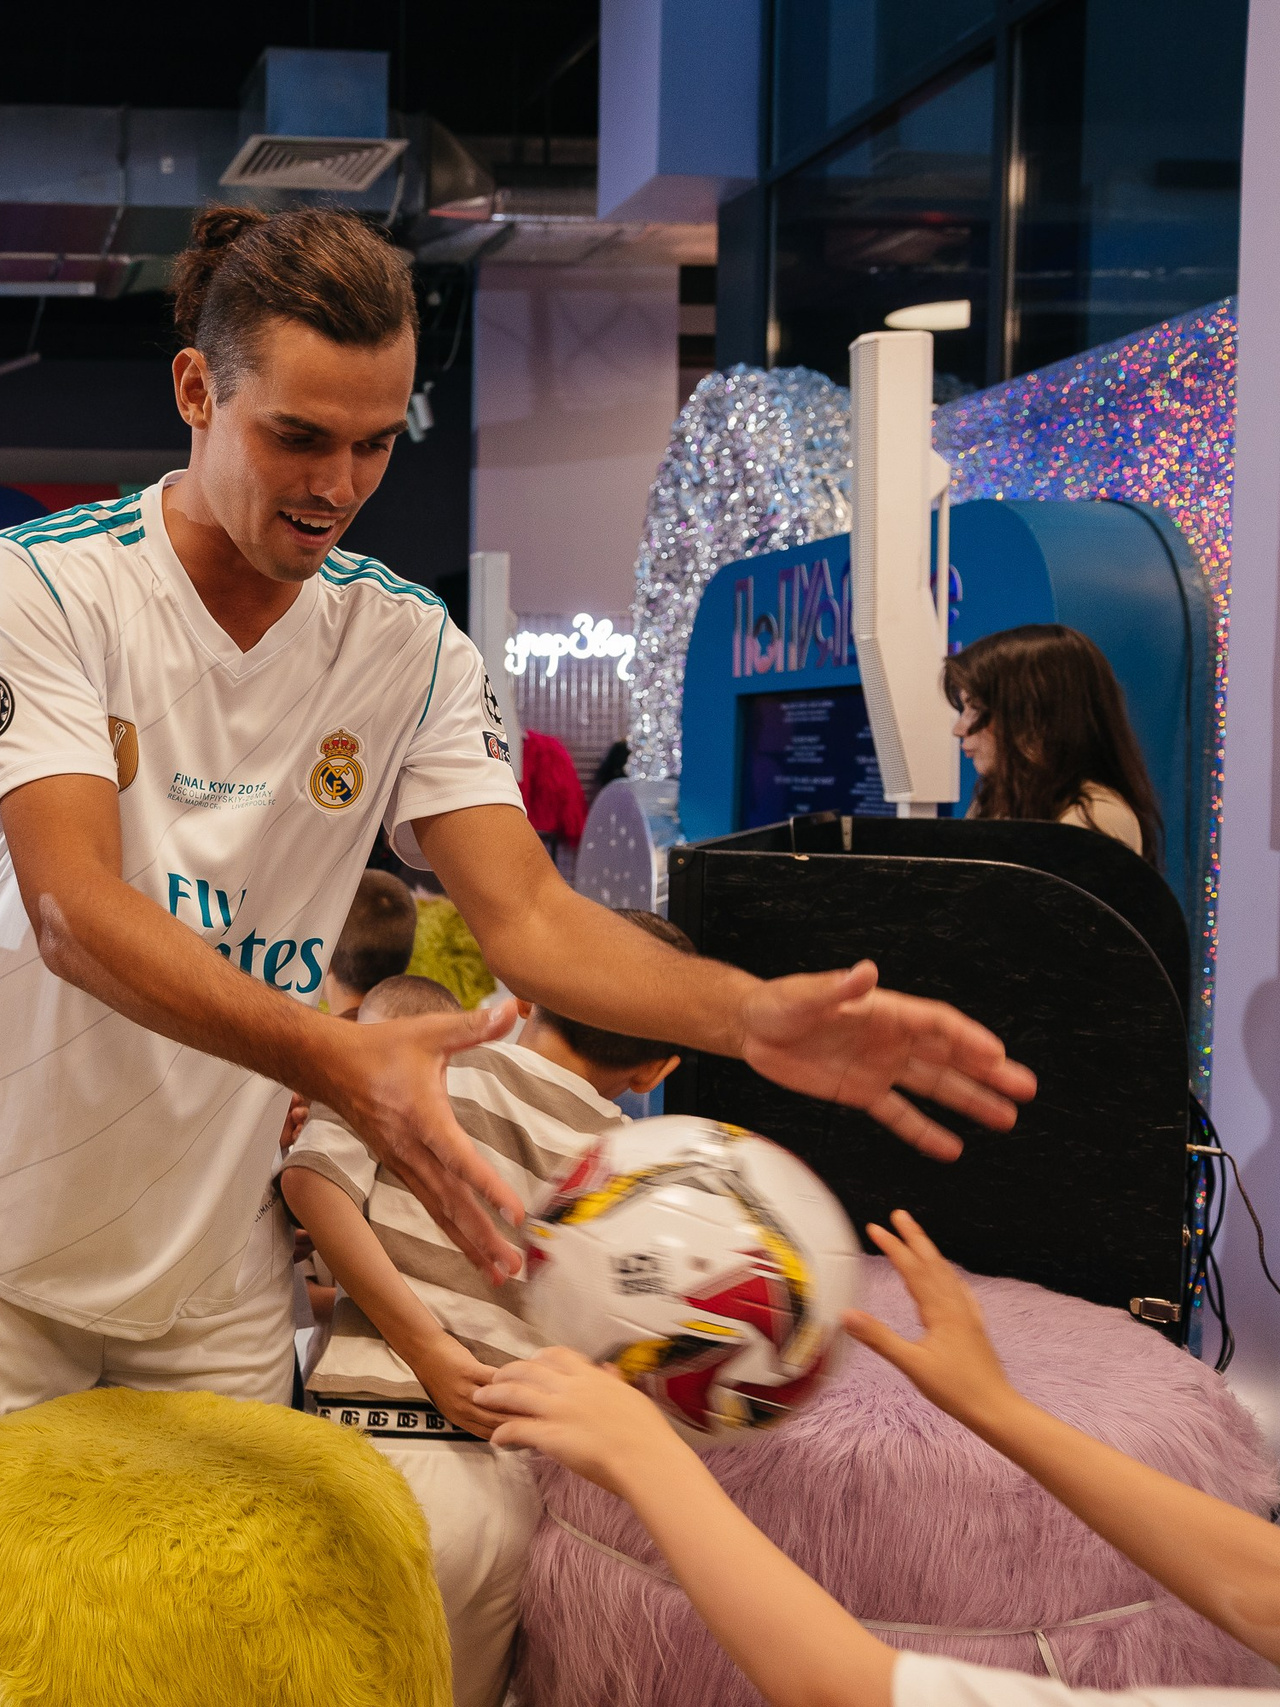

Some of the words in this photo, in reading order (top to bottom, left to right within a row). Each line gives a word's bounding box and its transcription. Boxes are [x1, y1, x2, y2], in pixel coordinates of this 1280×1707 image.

[170, 784, 188, 796] NSC
[173, 772, 206, 791] FINAL
[208, 781, 236, 794] KYIV
[167, 792, 184, 803] REAL
[184, 798, 209, 808] MADRID
[268, 798, 277, 806] FC
[167, 872, 248, 937] Fly
[367, 1410, 390, 1427] DG
[397, 1411, 419, 1429] DG
